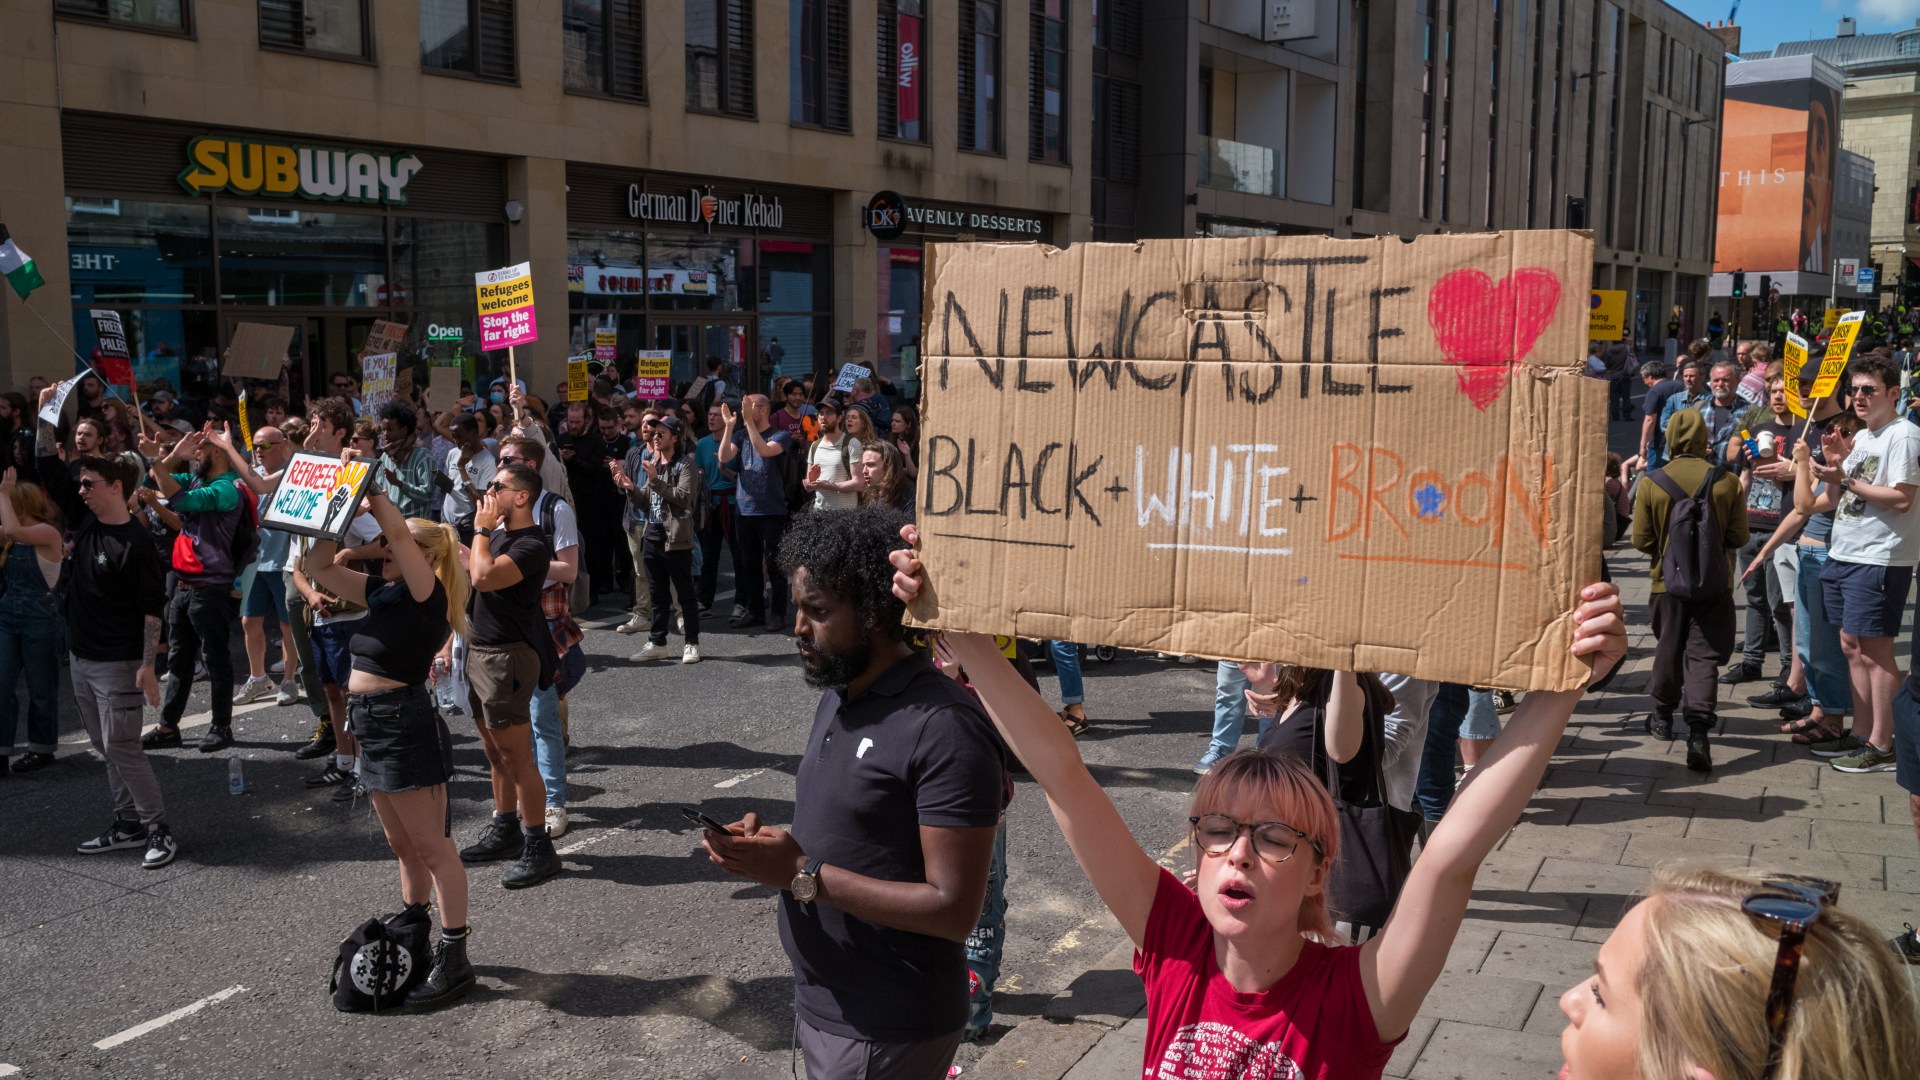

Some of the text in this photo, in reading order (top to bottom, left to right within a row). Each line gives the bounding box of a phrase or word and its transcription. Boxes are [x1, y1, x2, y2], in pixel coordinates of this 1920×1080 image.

[184, 138, 424, 204] SUBWAY
[1719, 167, 1785, 187] THIS
[628, 183, 686, 222] German
[744, 194, 783, 229] Kebab
[971, 213, 1042, 234] DESSERTS
[480, 280, 530, 298] Refugees
[481, 293, 529, 311] welcome
[482, 311, 529, 329] Stop the
[938, 254, 1414, 405] NEWCASTLE
[427, 323, 463, 340] Open
[483, 322, 530, 342] far right
[640, 359, 669, 368] Refugees
[639, 378, 666, 387] Stop the
[650, 386, 665, 396] right
[286, 460, 343, 493] REFUGEES
[925, 434, 1103, 527] BLACK
[1134, 442, 1291, 537] WHITE
[1327, 442, 1553, 549] BROON
[274, 489, 324, 520] WELCOME
